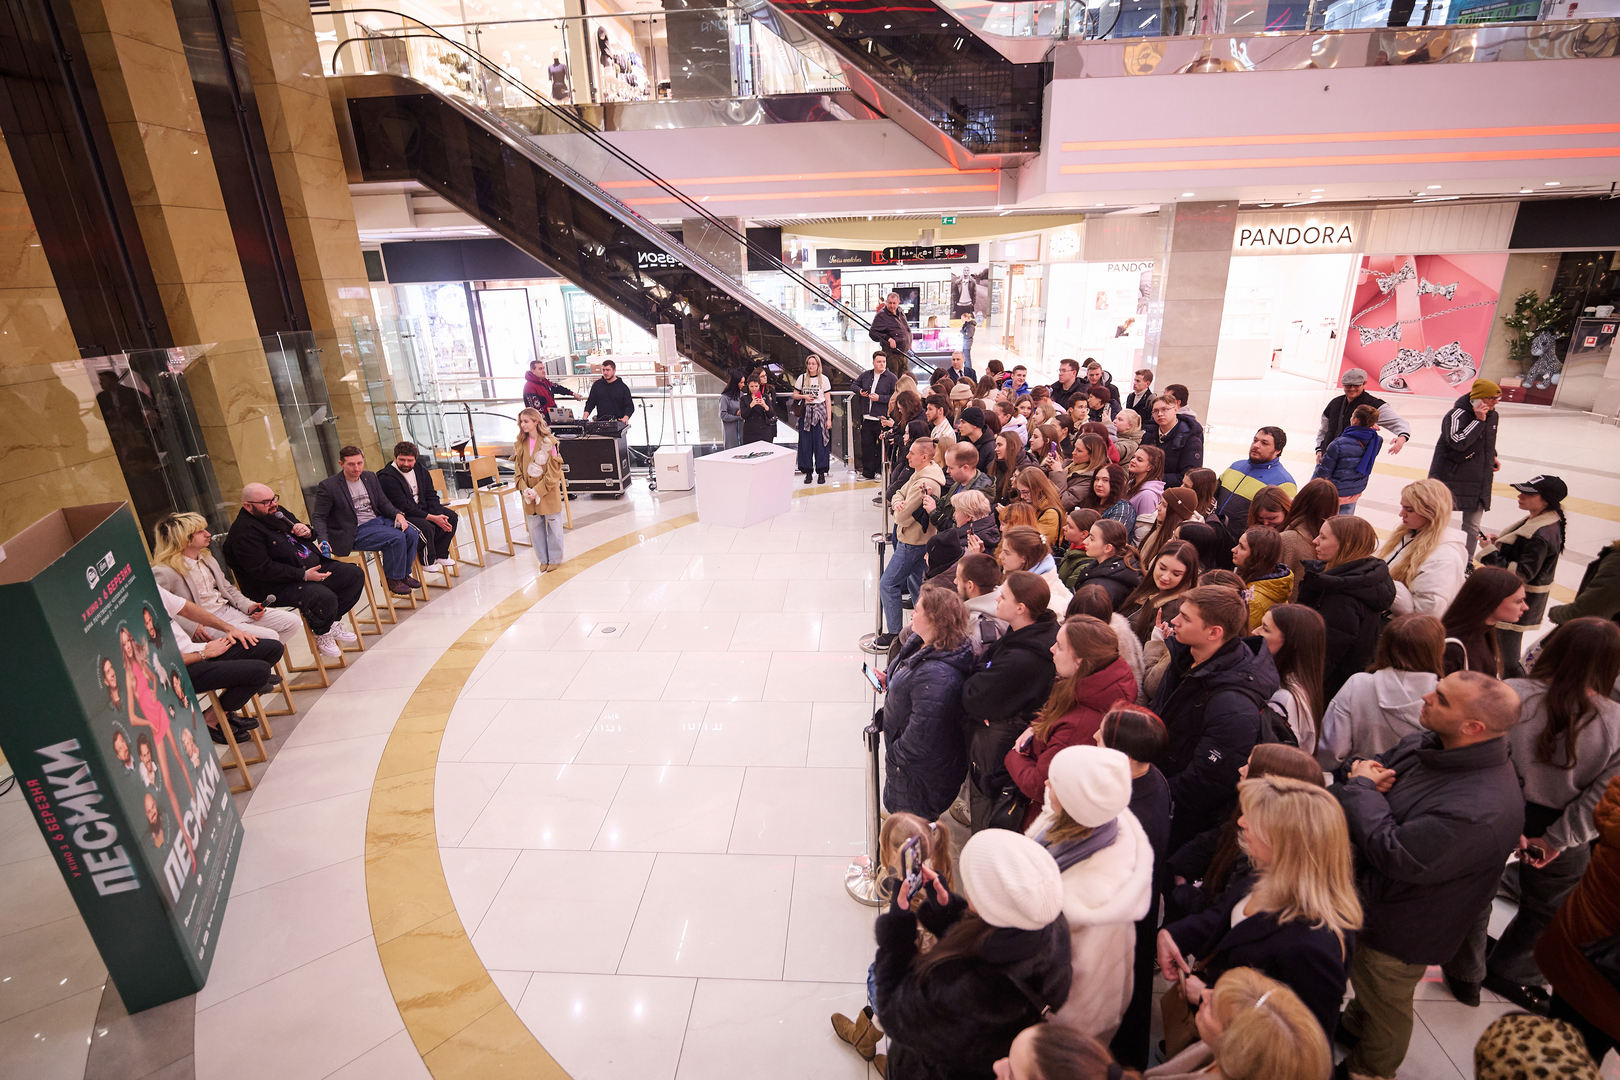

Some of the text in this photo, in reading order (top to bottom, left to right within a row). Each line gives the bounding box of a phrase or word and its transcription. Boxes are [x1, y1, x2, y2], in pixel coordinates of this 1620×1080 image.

[1496, 7, 1512, 19] ON
[1515, 4, 1531, 16] ME
[1240, 226, 1352, 246] PANDORA
[82, 613, 87, 621] У
[102, 588, 109, 600] 6
[107, 563, 132, 595] БЕРЕЗНЯ
[26, 778, 60, 833] БЕРЕЗНЯ
[34, 738, 141, 896] ПЕСИКИ
[52, 833, 65, 841] 6
[163, 752, 221, 904] ПЕСИКИ
[63, 851, 79, 871] КІНО
